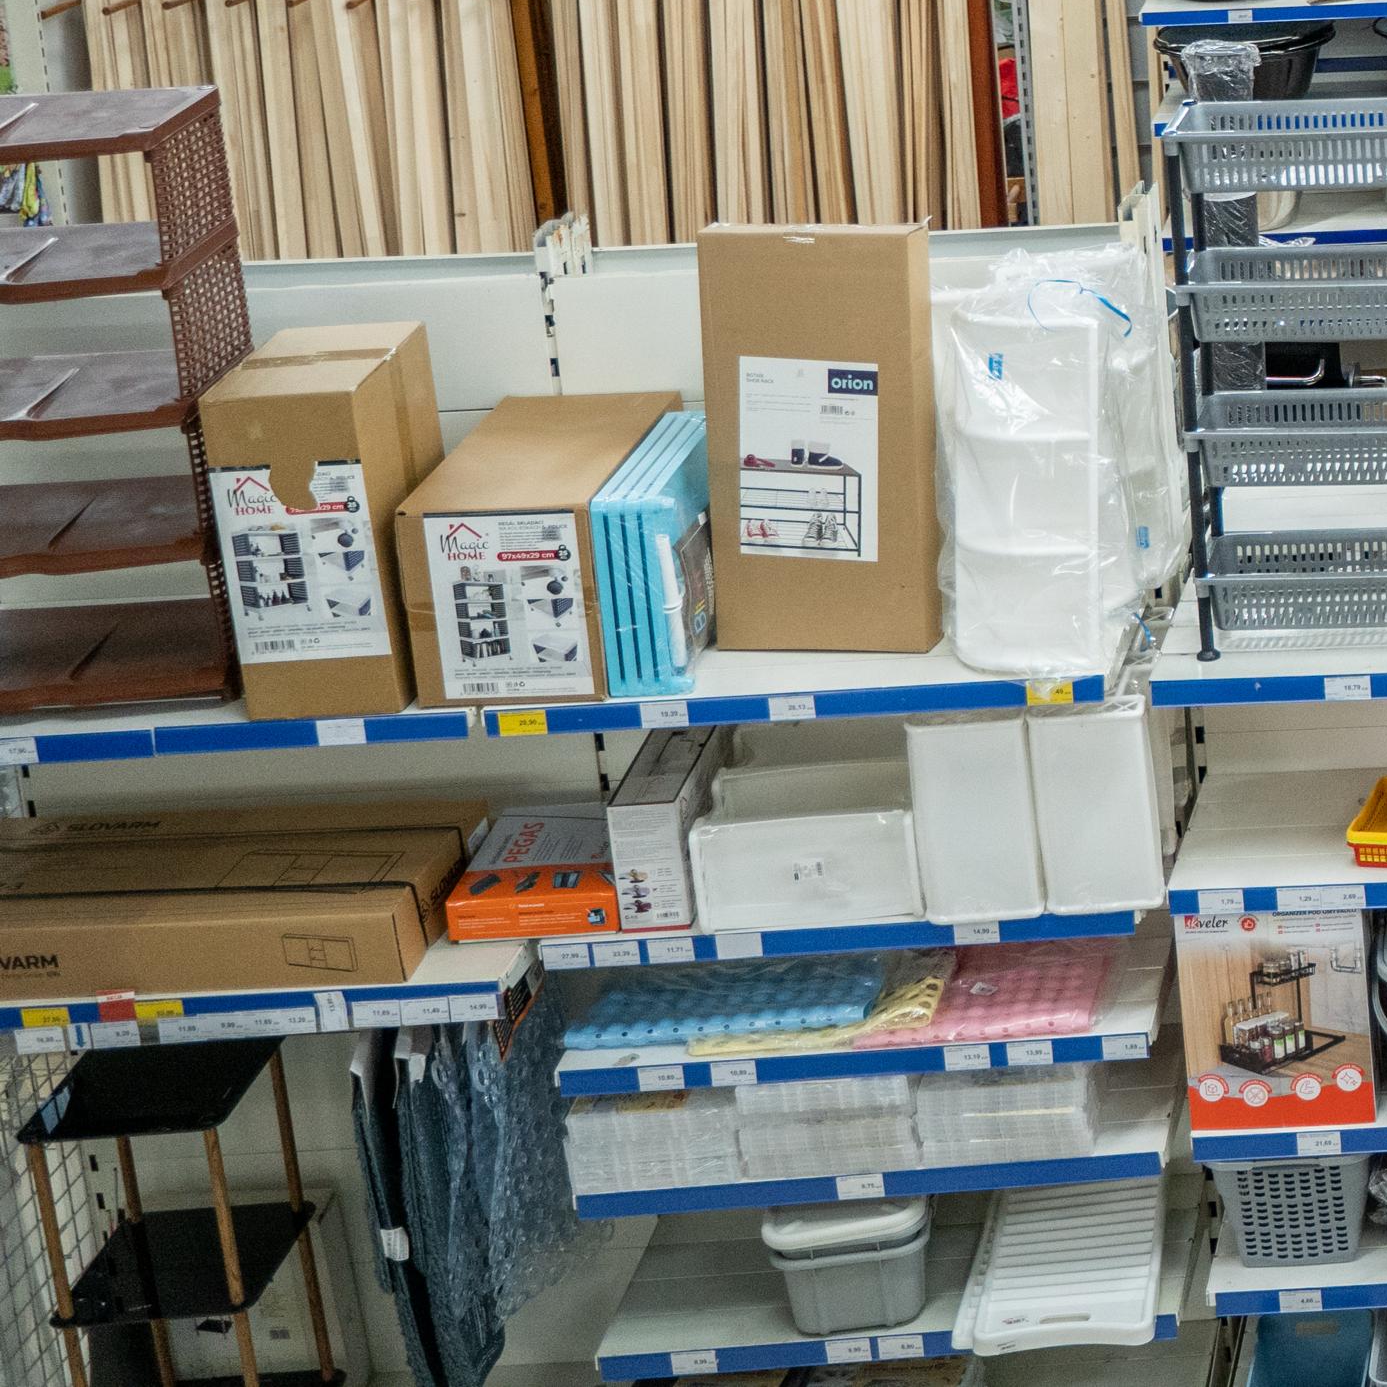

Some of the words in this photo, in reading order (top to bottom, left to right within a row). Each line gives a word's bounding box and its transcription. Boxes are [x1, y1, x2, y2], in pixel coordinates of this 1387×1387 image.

[831, 375, 874, 391] orion
[227, 488, 278, 508] Magic
[235, 506, 275, 516] HOME
[440, 534, 489, 554] Magic
[447, 551, 486, 561] HOME
[501, 552, 540, 560] 97x49x29
[503, 821, 545, 863] PEGAS
